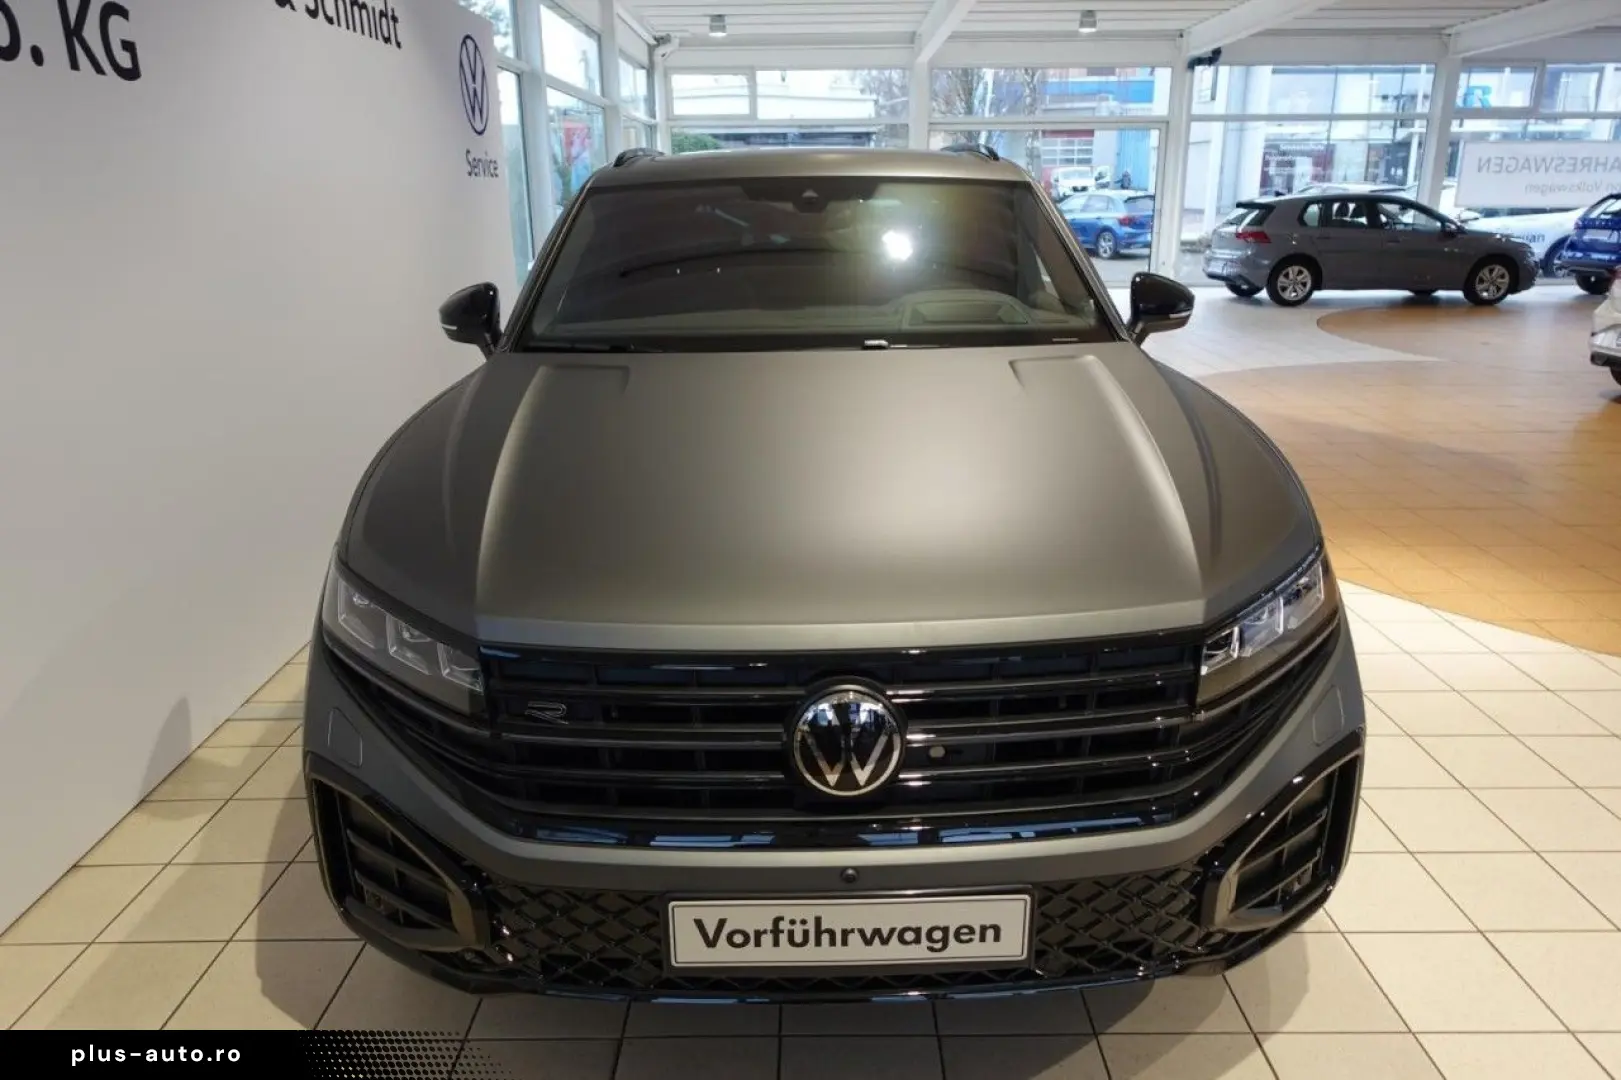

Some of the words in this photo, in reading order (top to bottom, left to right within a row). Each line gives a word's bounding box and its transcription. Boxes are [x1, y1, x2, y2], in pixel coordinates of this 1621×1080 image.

[57, 0, 142, 81] KG
[465, 148, 499, 178] Service
[693, 915, 1002, 953] Vorführwagen
